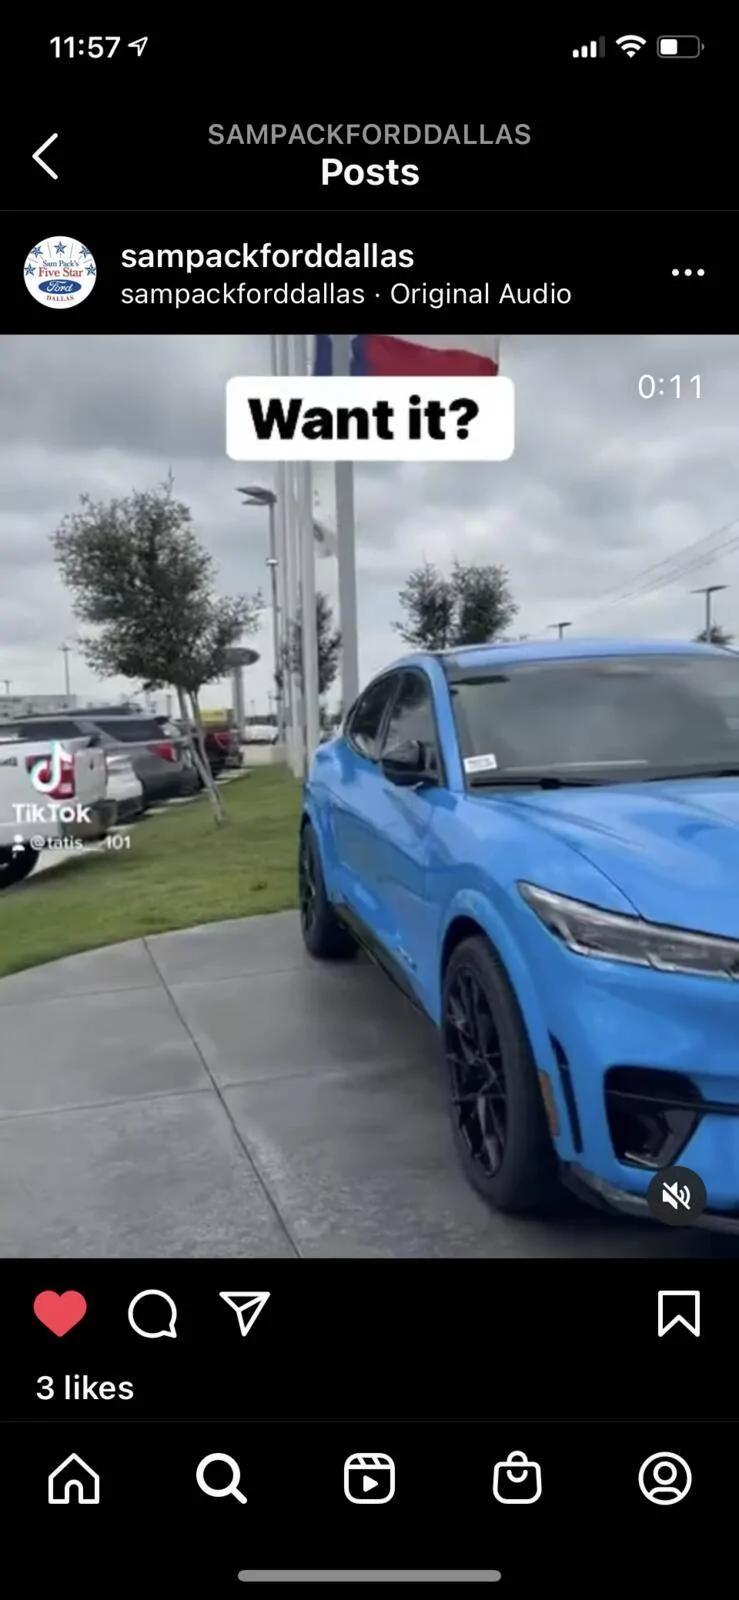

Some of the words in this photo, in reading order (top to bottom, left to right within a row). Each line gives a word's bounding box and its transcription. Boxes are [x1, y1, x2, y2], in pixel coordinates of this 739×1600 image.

[50, 36, 121, 59] 11:57
[208, 123, 532, 146] SAMPACKFORDDALLAS
[322, 157, 420, 186] Posts
[121, 242, 414, 274] sampackforddallas
[38, 267, 60, 278] Five
[63, 267, 83, 278] Star
[46, 281, 73, 292] Ford
[121, 283, 365, 309] sampackforddallas
[390, 282, 488, 309] Original
[498, 282, 572, 305] Audio
[36, 1375, 55, 1400] 3
[65, 1373, 134, 1400] likes
